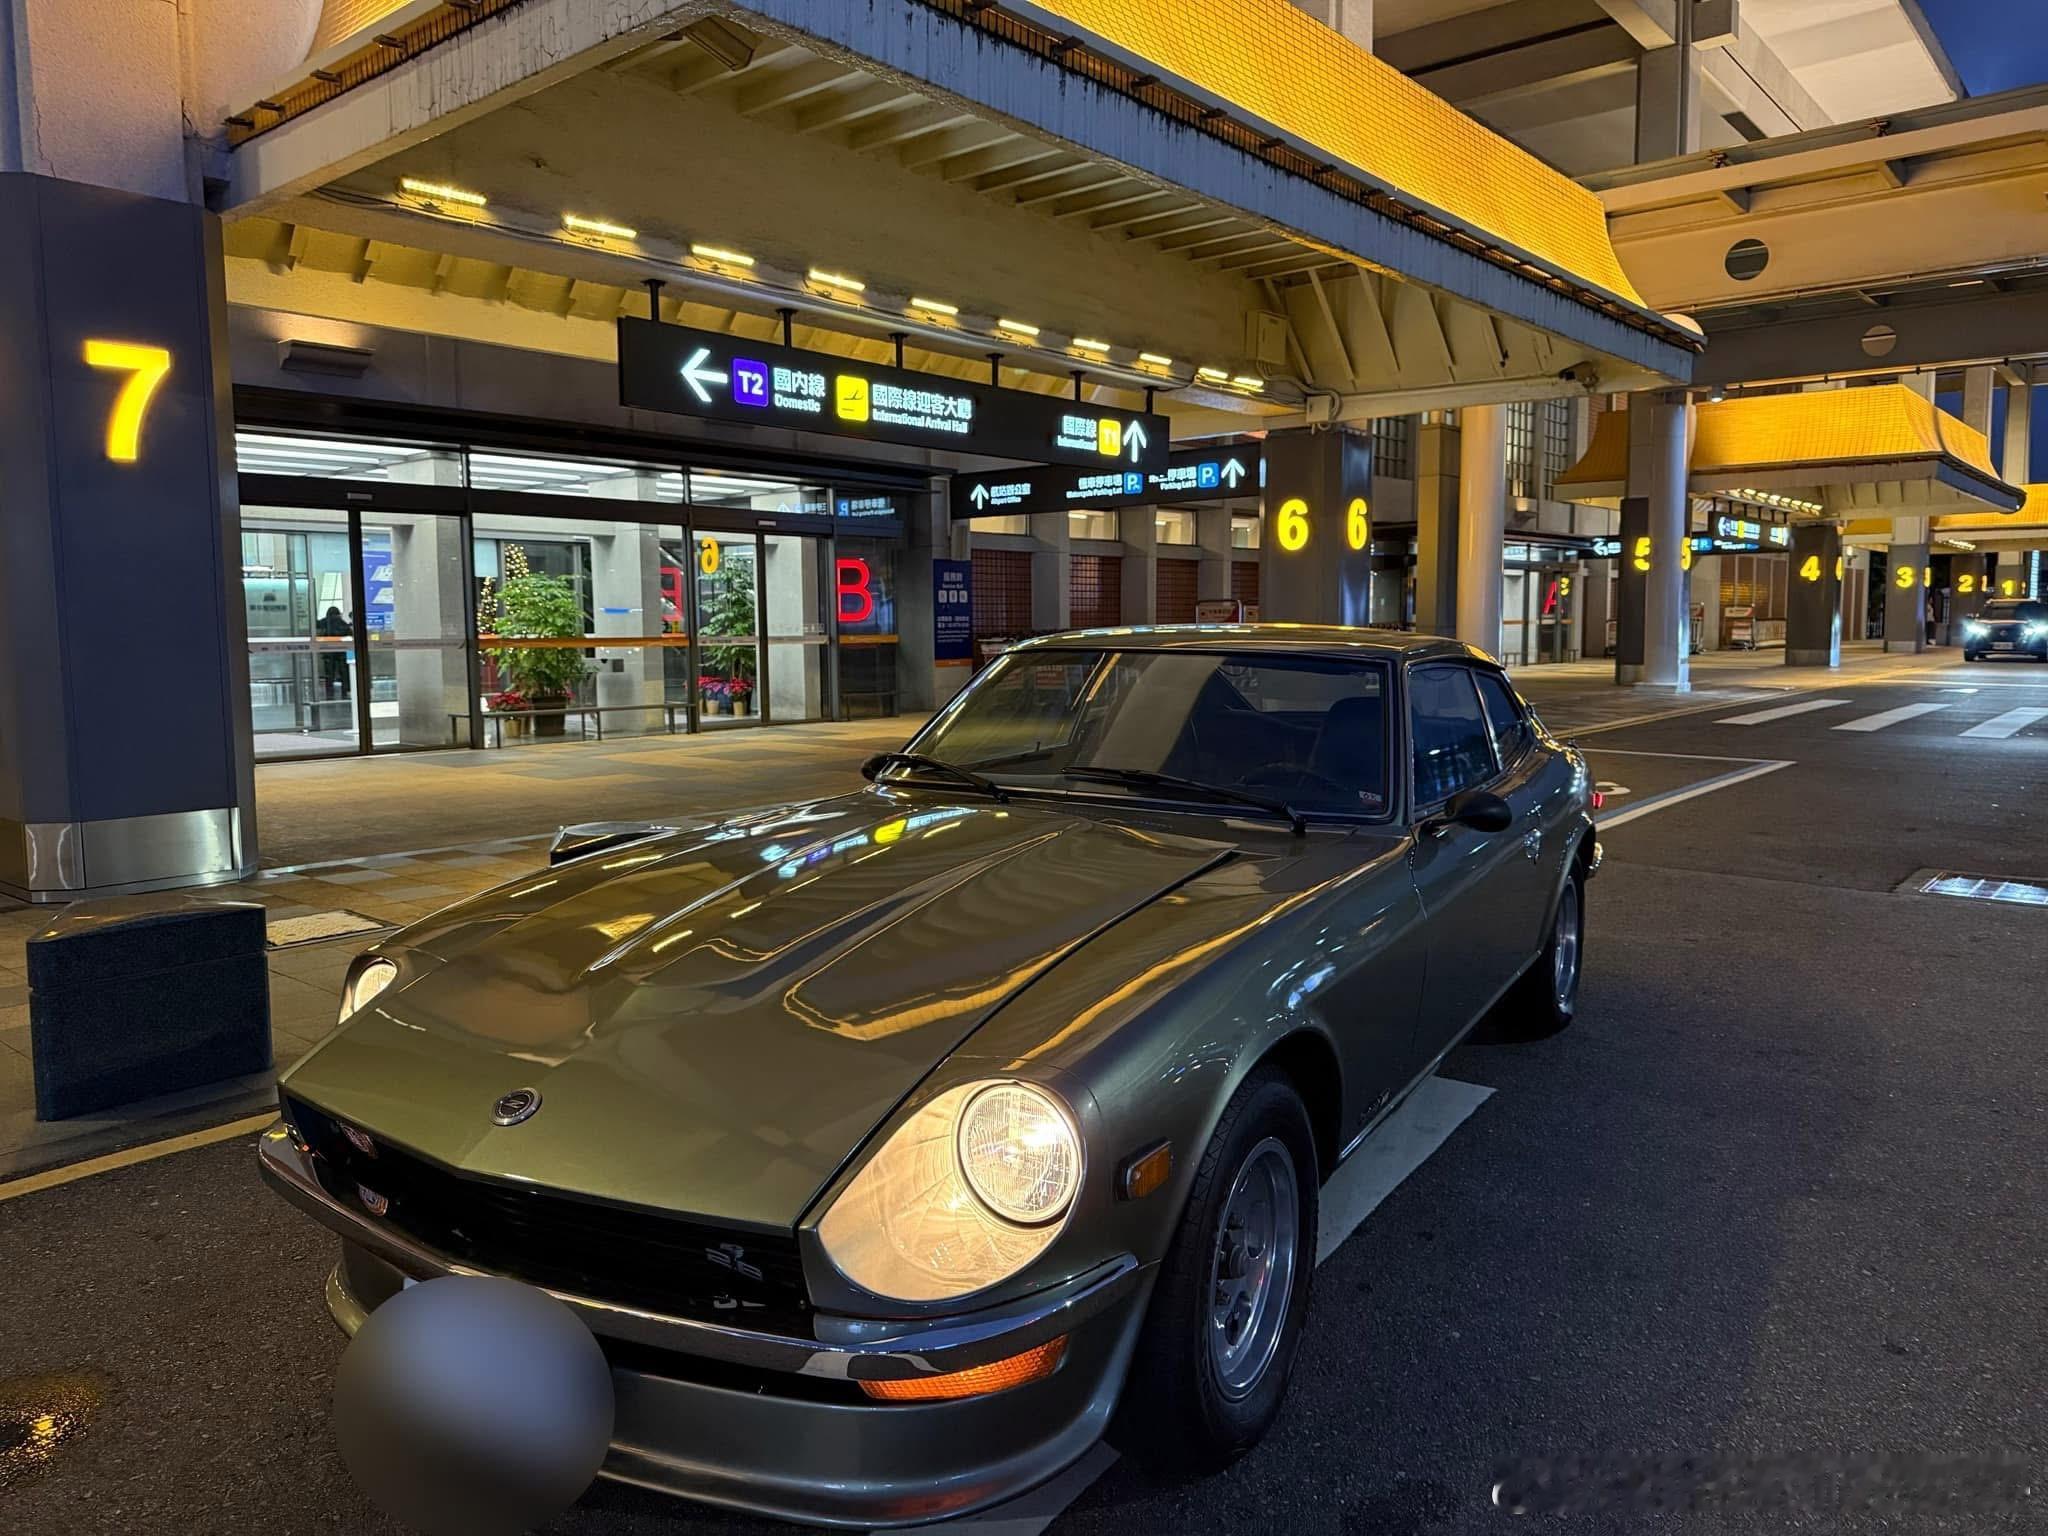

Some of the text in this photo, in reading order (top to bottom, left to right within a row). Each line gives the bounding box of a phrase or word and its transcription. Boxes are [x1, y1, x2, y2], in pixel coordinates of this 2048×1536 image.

[738, 370, 763, 395] T2
[774, 367, 825, 397] 國內線
[84, 339, 170, 462] 7
[774, 393, 821, 412] Domestic
[1278, 499, 1308, 550] 6
[1347, 498, 1367, 549] 6
[1799, 555, 1820, 582] 4
[1896, 566, 1914, 588] 3
[836, 557, 873, 622] B
[1958, 574, 1973, 592] 2
[2002, 580, 2013, 595] 1
